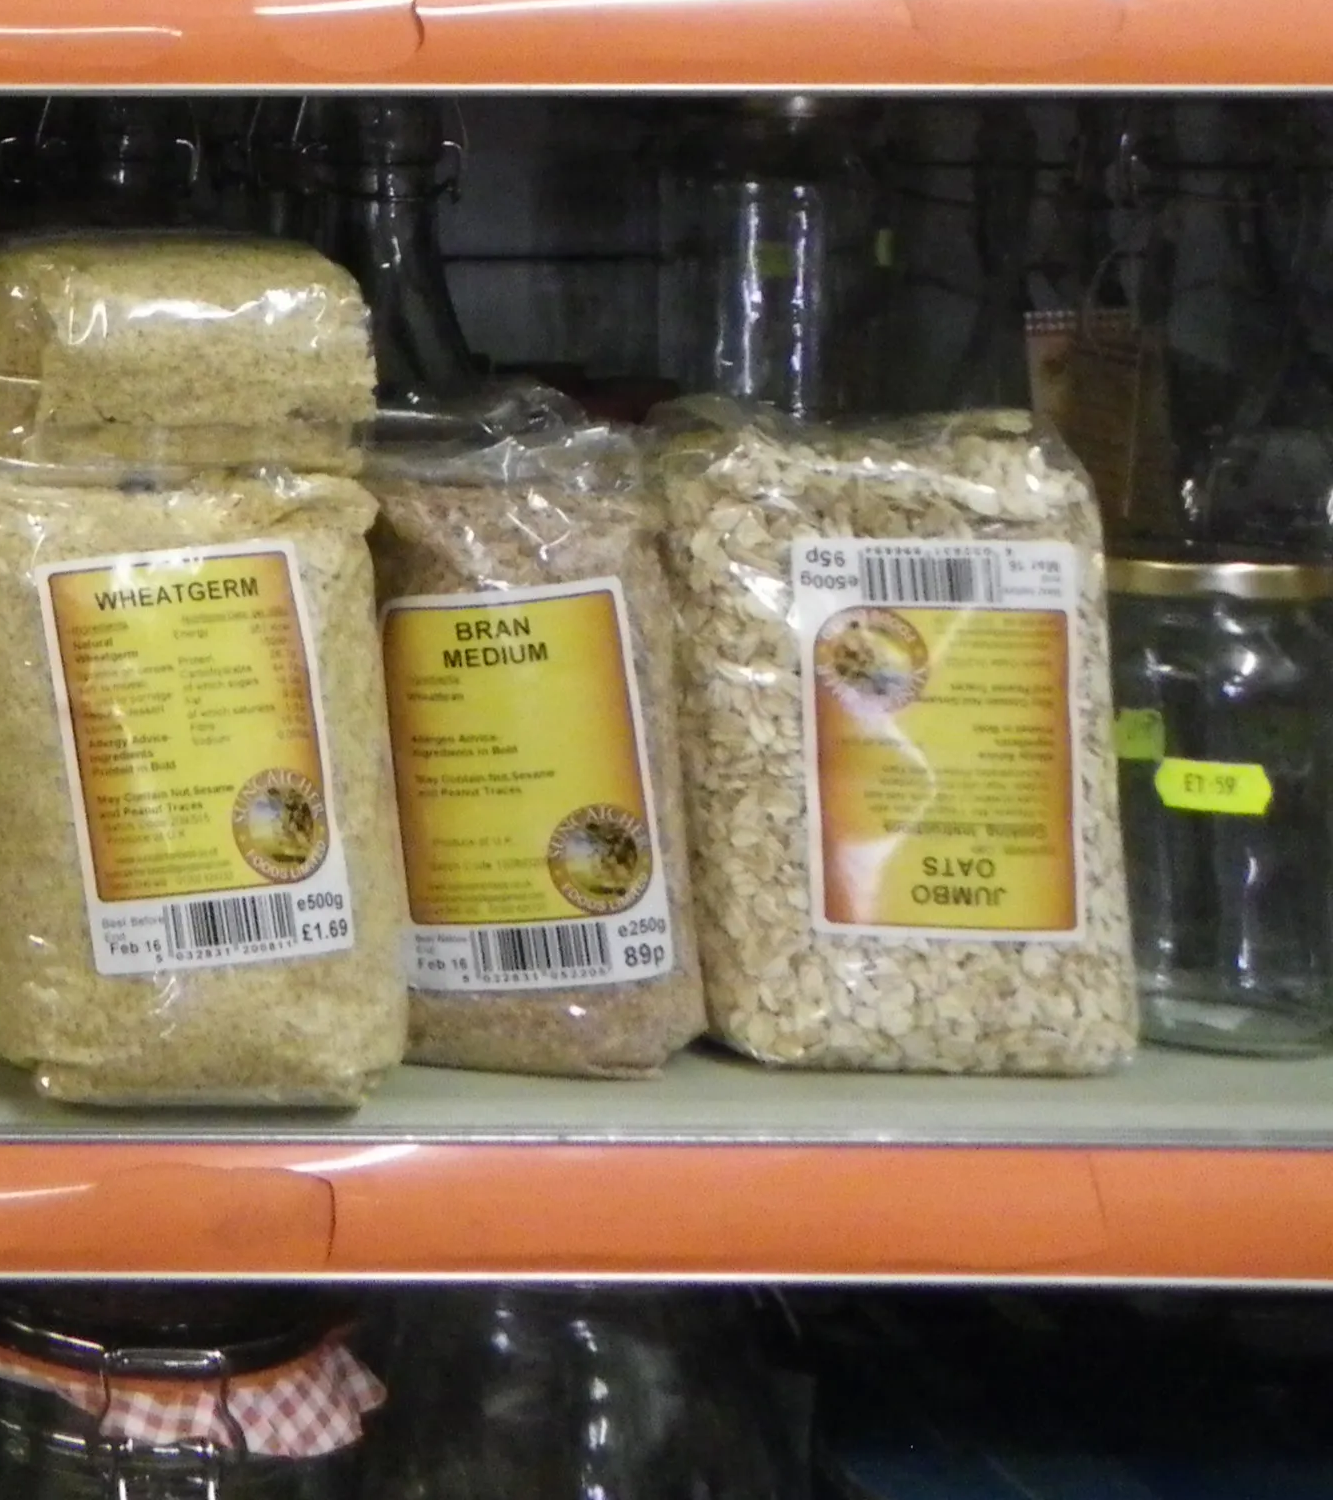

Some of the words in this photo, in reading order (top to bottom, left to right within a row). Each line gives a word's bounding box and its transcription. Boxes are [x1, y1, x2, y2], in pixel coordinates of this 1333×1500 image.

[805, 546, 846, 567] 95p
[94, 576, 260, 613] WHEATGERM
[455, 616, 531, 642] BRAN
[442, 642, 549, 669] MEDIUM
[923, 855, 996, 878] OATS
[911, 884, 1009, 907] JUMBO
[301, 918, 349, 942] £1.69
[110, 940, 140, 956] Feb
[145, 939, 162, 953] 16
[623, 944, 666, 969] 89p
[417, 957, 446, 971] Feb
